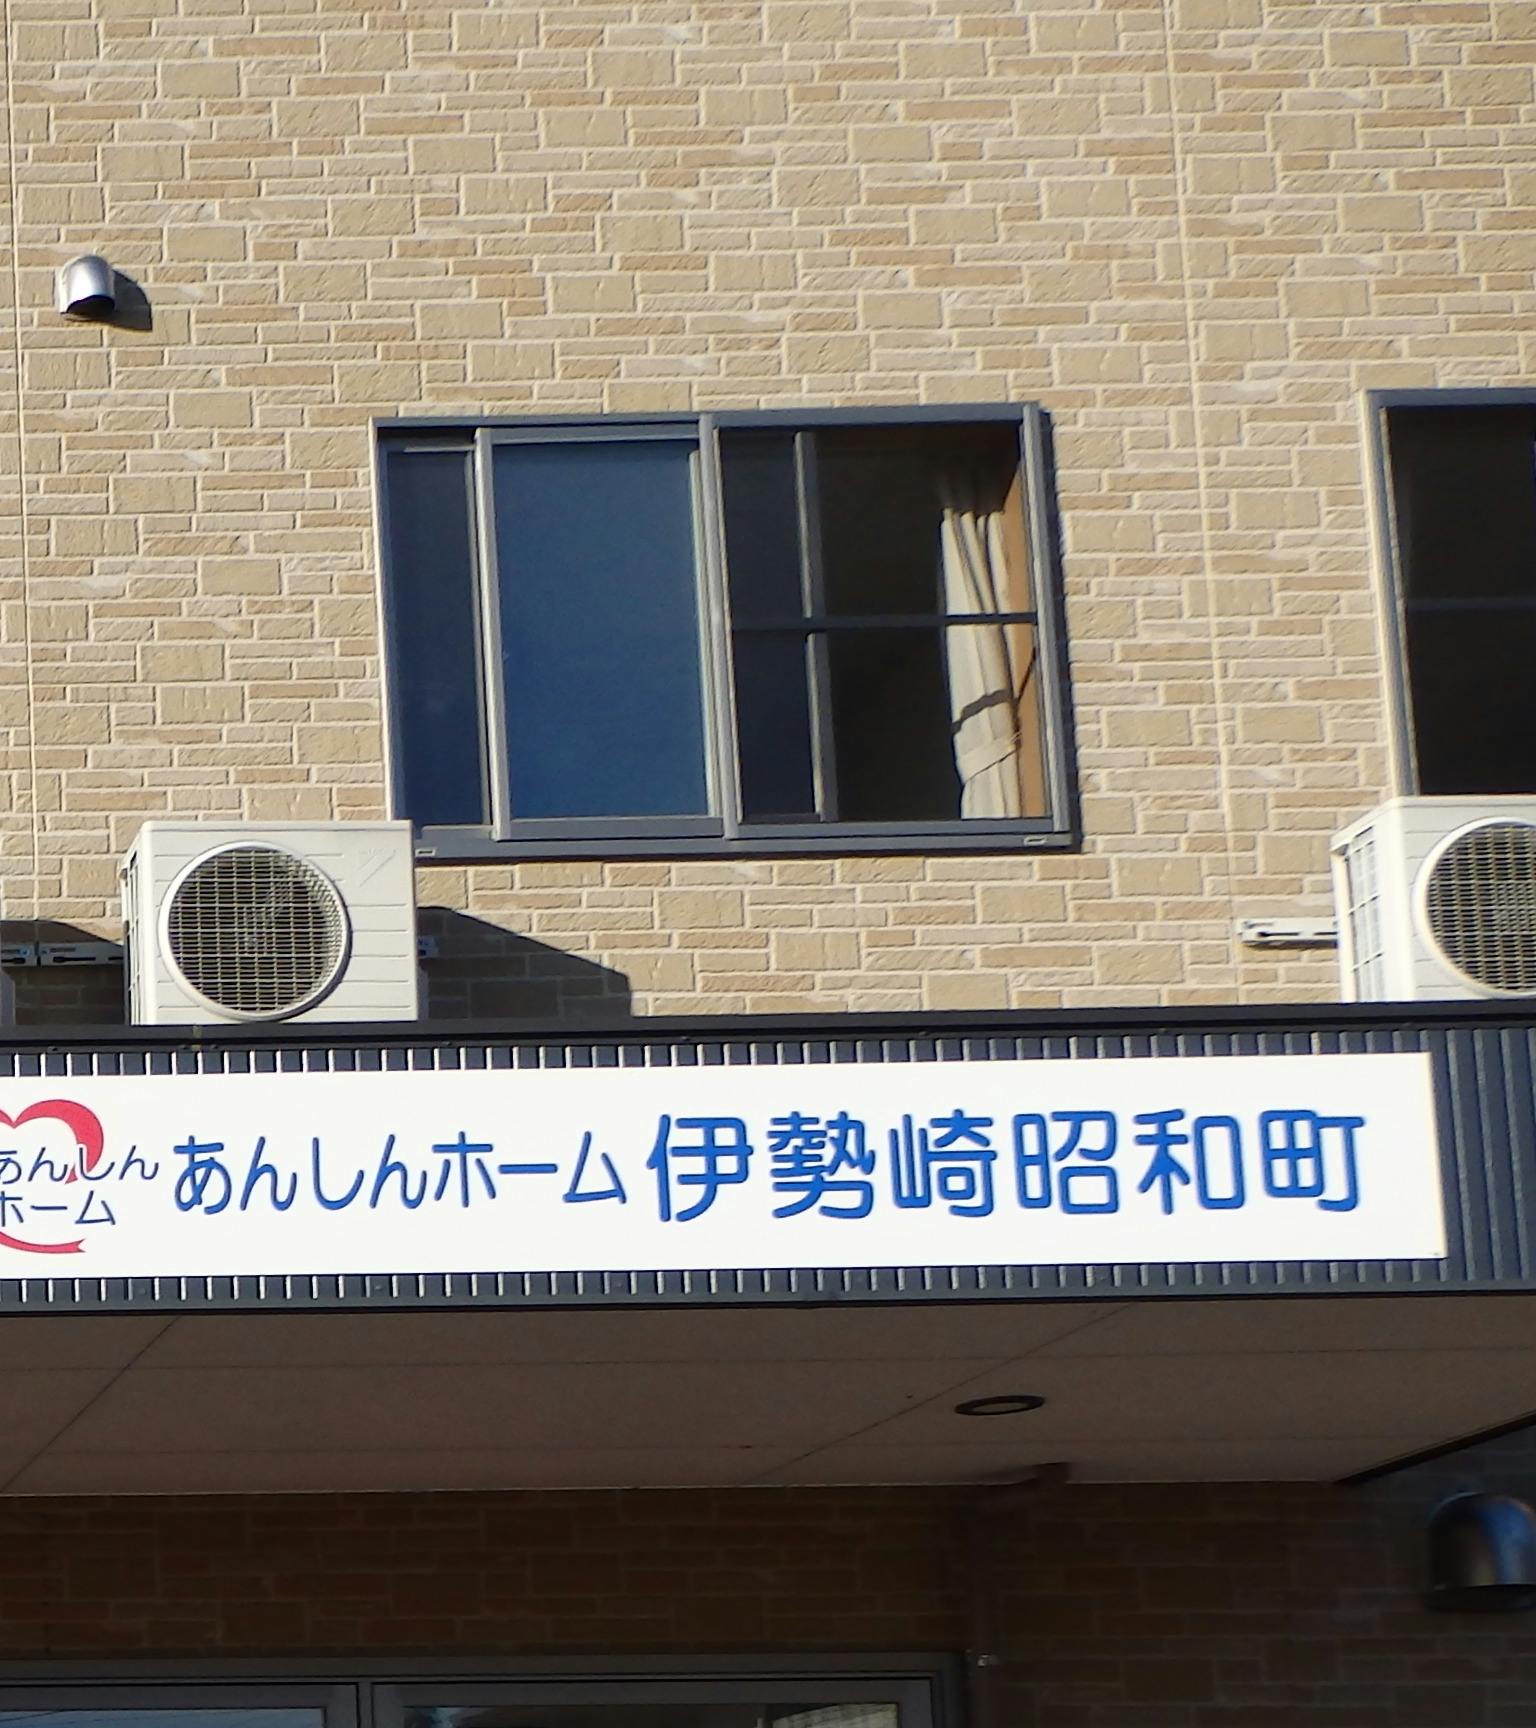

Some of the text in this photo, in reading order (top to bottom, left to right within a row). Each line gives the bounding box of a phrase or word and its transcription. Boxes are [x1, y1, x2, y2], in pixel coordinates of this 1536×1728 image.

[173, 1108, 1367, 1223] あんしんホーム 伊勢崎昭和町
